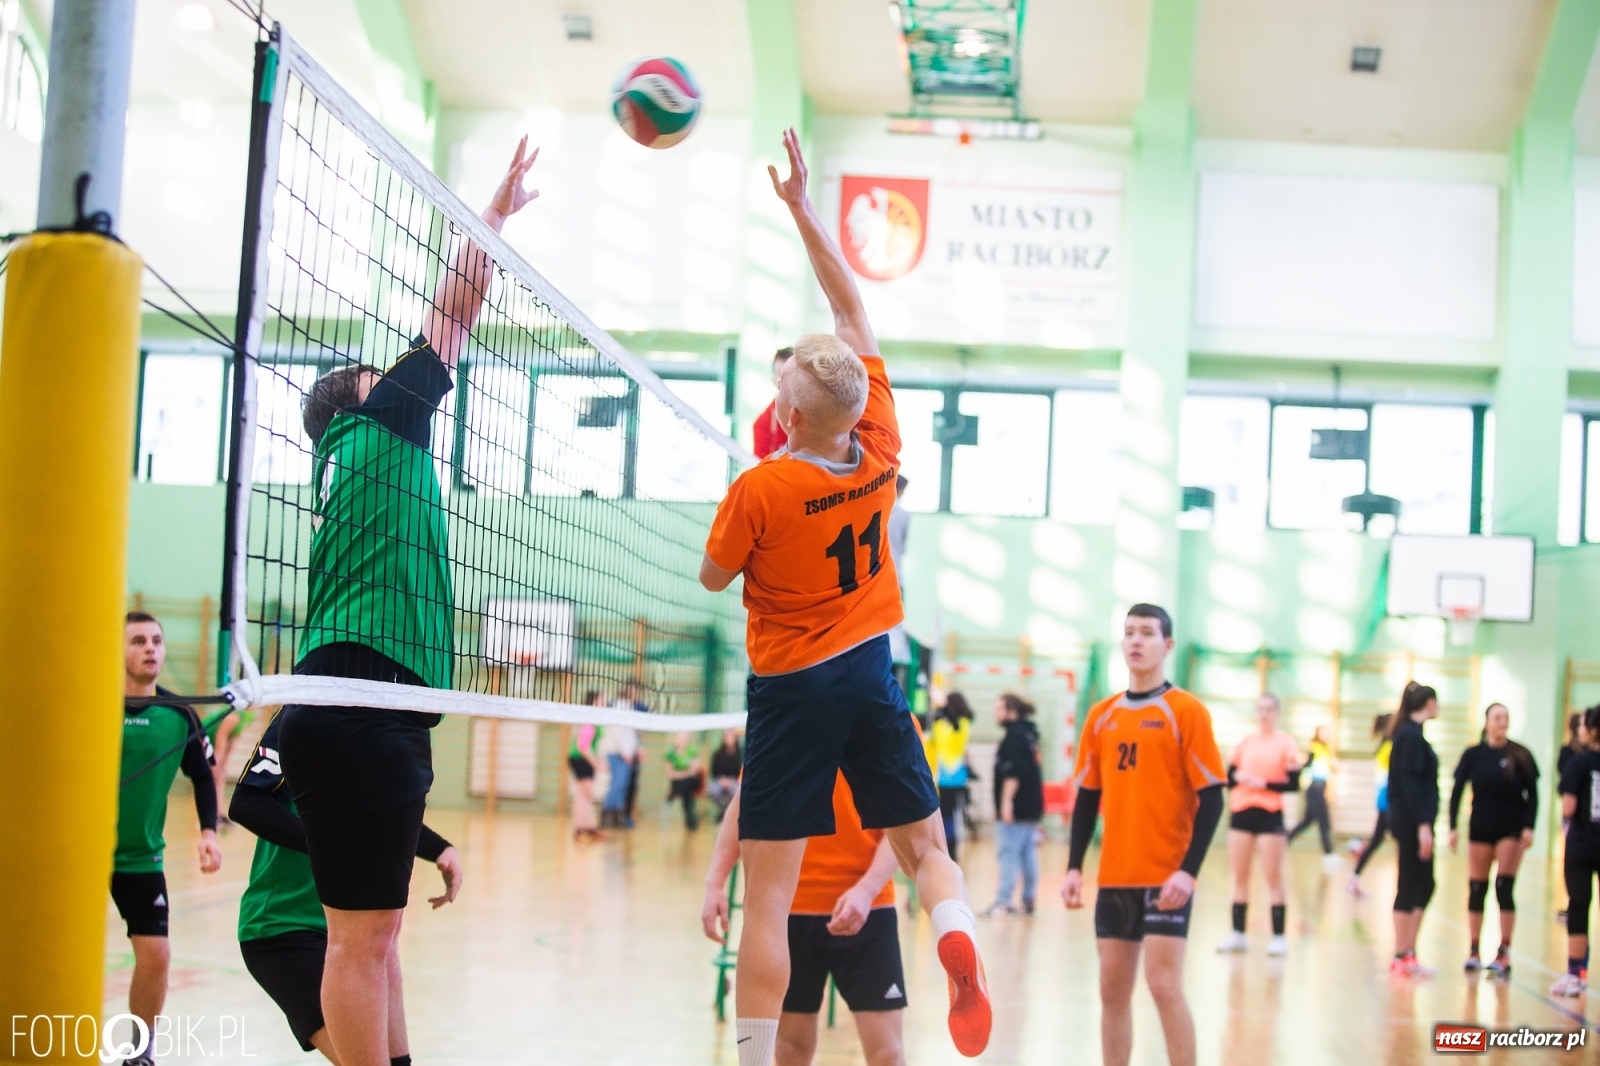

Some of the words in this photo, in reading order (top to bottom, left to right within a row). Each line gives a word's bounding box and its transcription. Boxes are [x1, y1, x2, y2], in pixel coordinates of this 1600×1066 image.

[971, 202, 1093, 232] MIASTO
[947, 236, 1112, 271] RACIBÓRZ
[804, 492, 846, 516] ZSOMS
[825, 509, 882, 595] 11
[1117, 742, 1138, 771] 24
